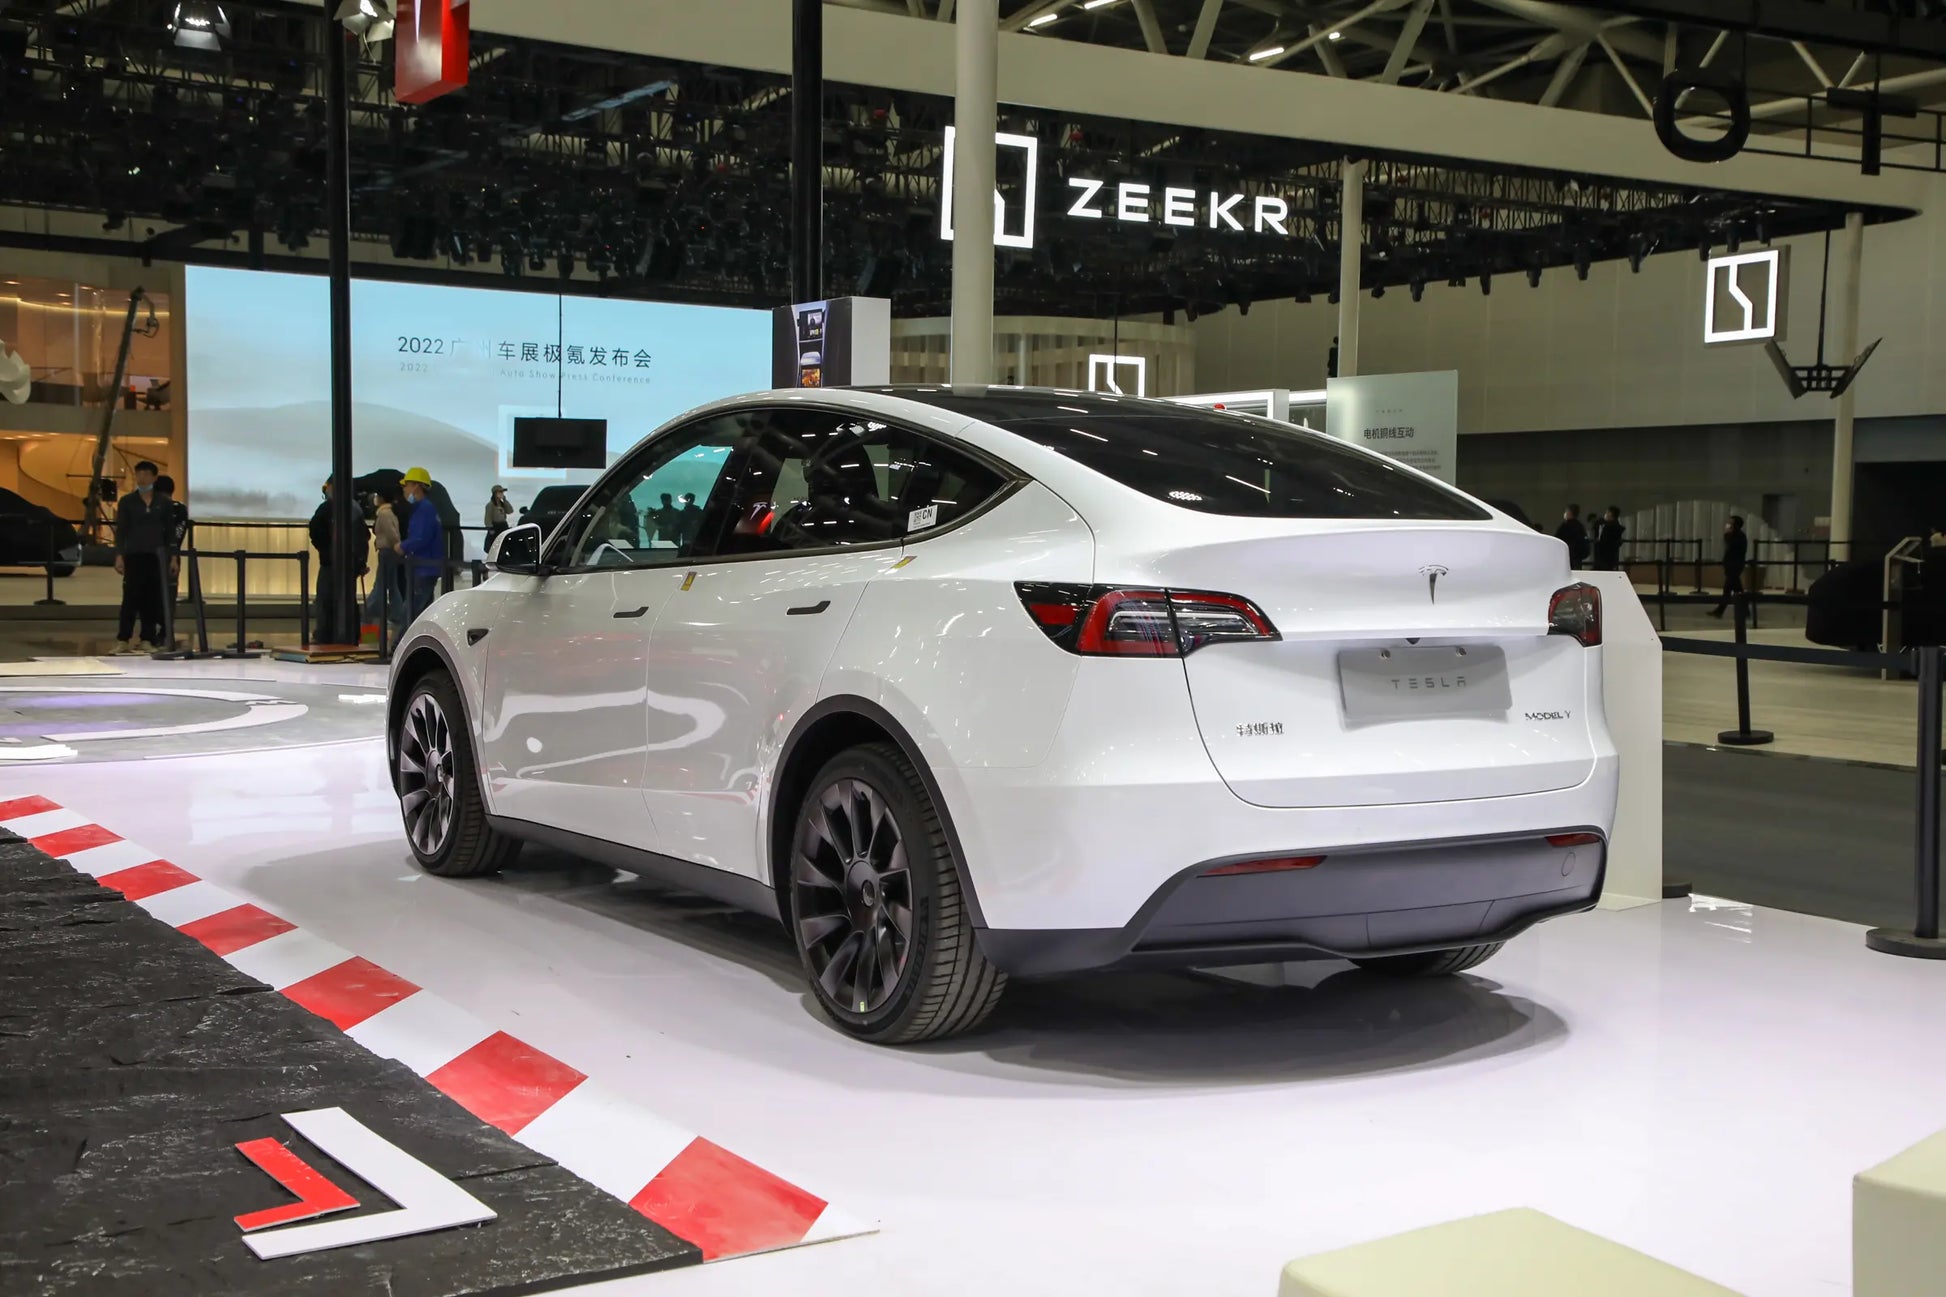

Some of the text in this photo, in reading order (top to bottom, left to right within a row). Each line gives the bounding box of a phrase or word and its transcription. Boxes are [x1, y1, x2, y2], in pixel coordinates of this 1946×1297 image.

[1066, 177, 1289, 235] ZEEKR
[398, 336, 444, 354] 2022
[500, 368, 525, 378] Auto
[529, 369, 556, 379] Show
[592, 373, 651, 384] Conference
[922, 507, 933, 520] CN
[1391, 676, 1466, 689] TESLA
[1525, 710, 1571, 720] MODEL Y
